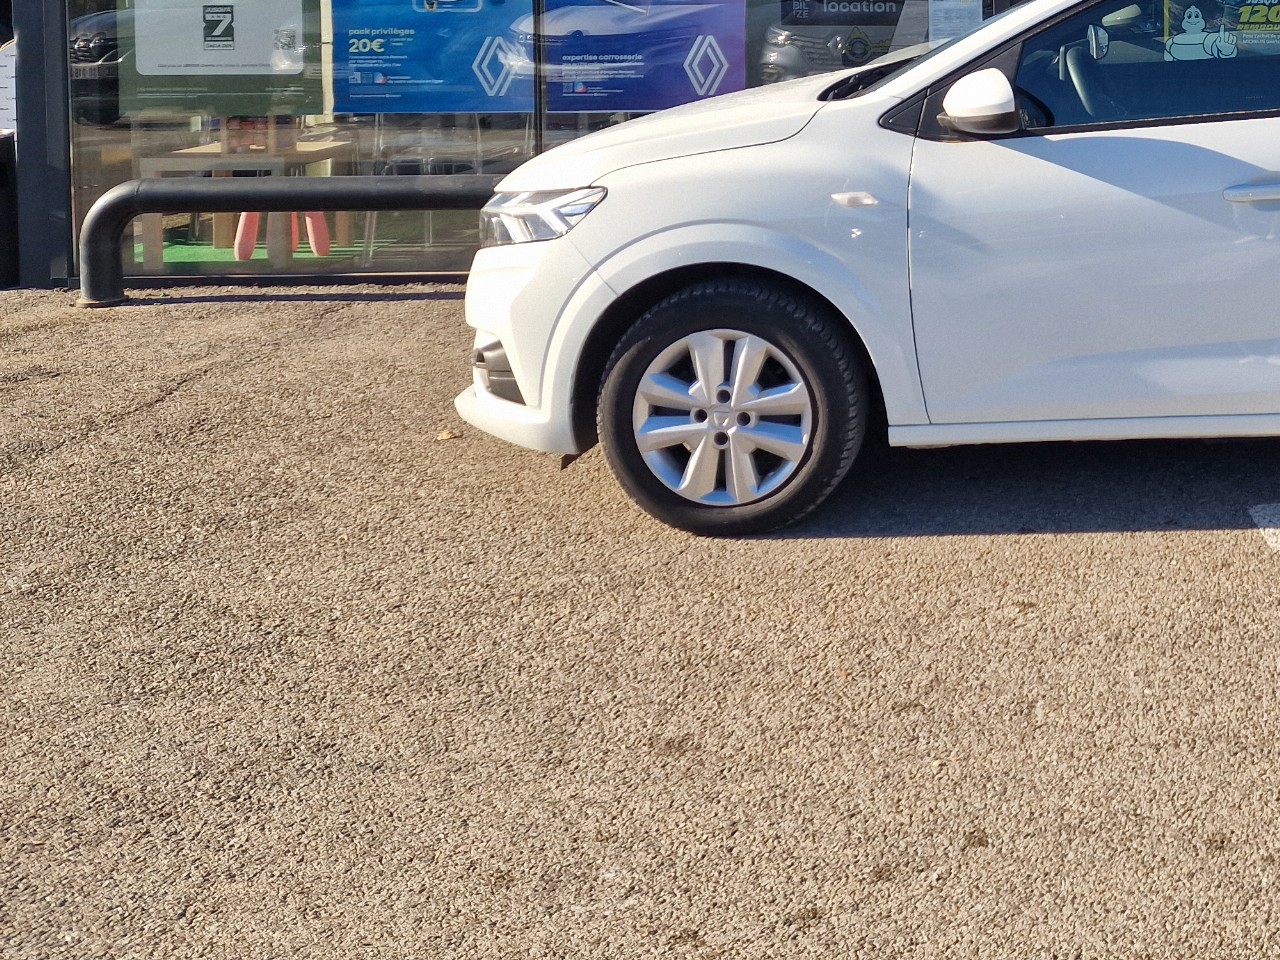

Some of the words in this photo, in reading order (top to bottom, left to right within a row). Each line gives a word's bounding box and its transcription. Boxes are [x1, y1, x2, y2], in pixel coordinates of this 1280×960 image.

[823, 0, 896, 13] location
[348, 28, 370, 36] pack
[371, 27, 416, 37] privilèges
[562, 53, 598, 62] expertise
[598, 52, 642, 61] carrosserie
